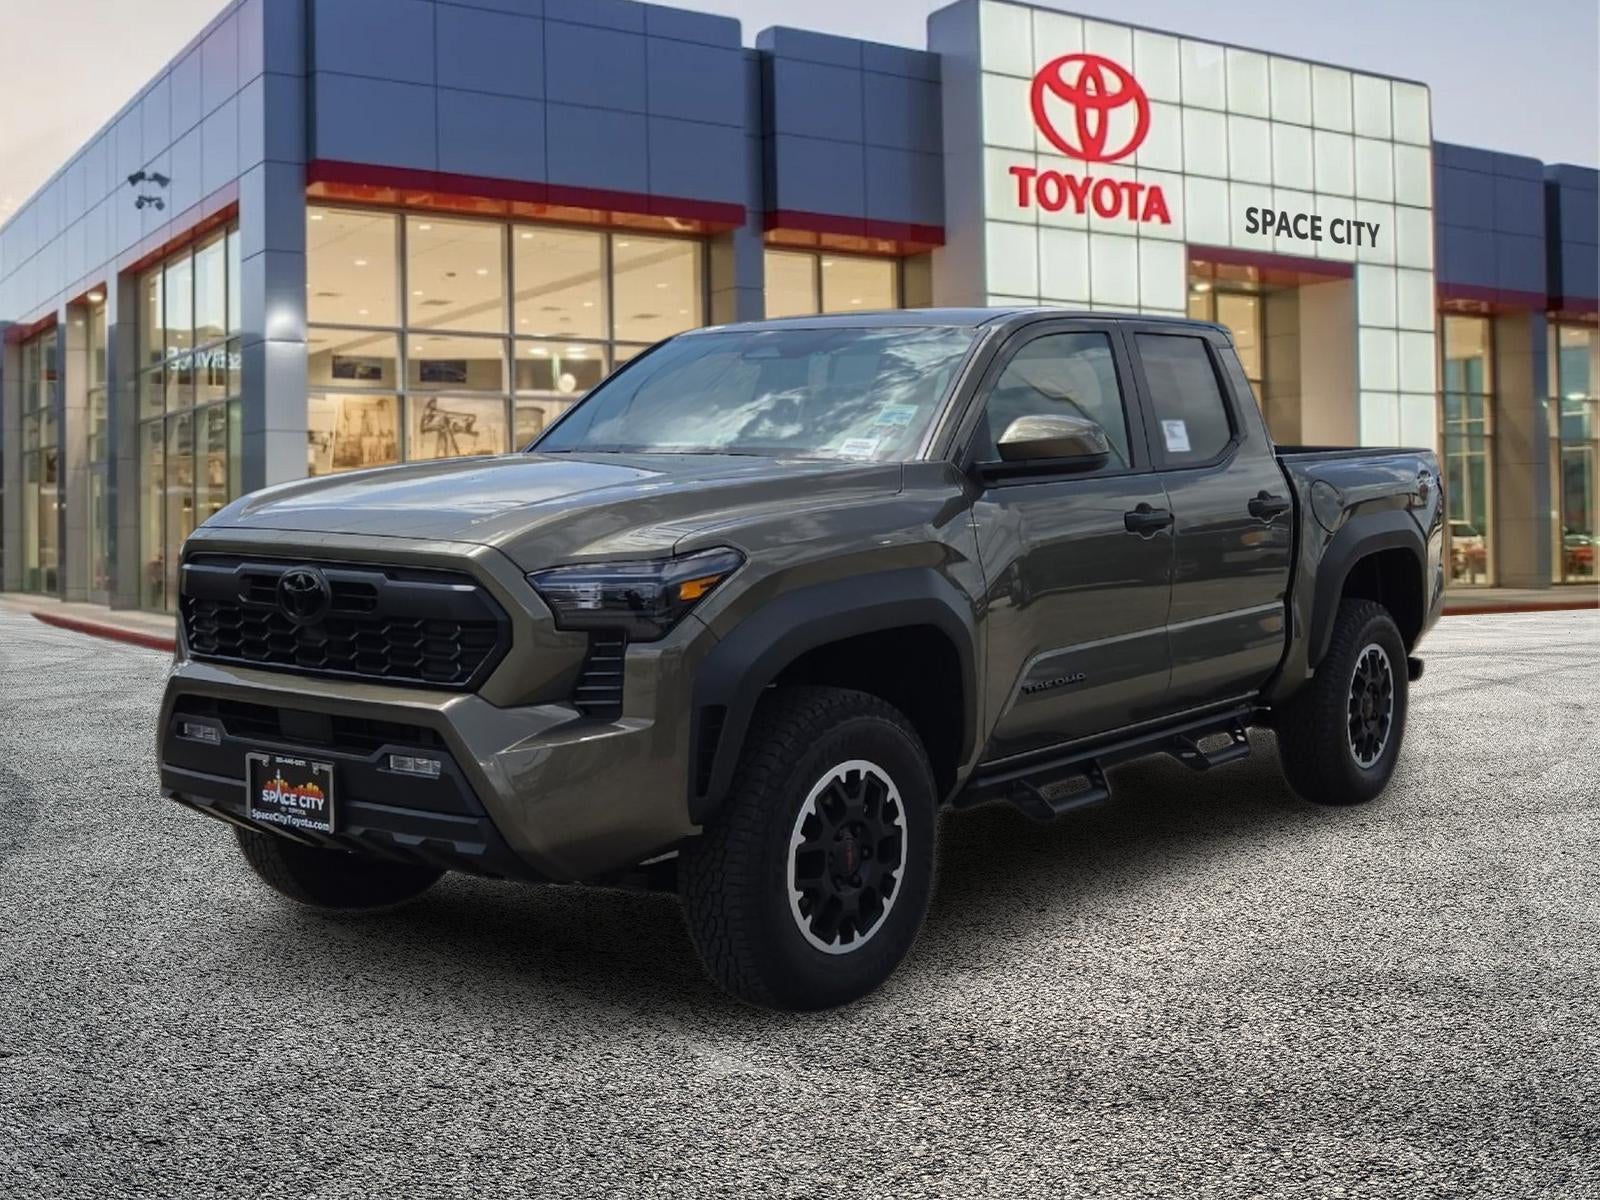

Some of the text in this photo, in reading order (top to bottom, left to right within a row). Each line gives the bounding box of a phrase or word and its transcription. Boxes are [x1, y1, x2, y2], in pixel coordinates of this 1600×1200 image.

[1009, 166, 1171, 224] TOYOTA
[1245, 206, 1381, 248] SPACE CITY
[262, 789, 324, 811] SPACE CITY
[251, 808, 330, 831] SpaceCityToyota.com
